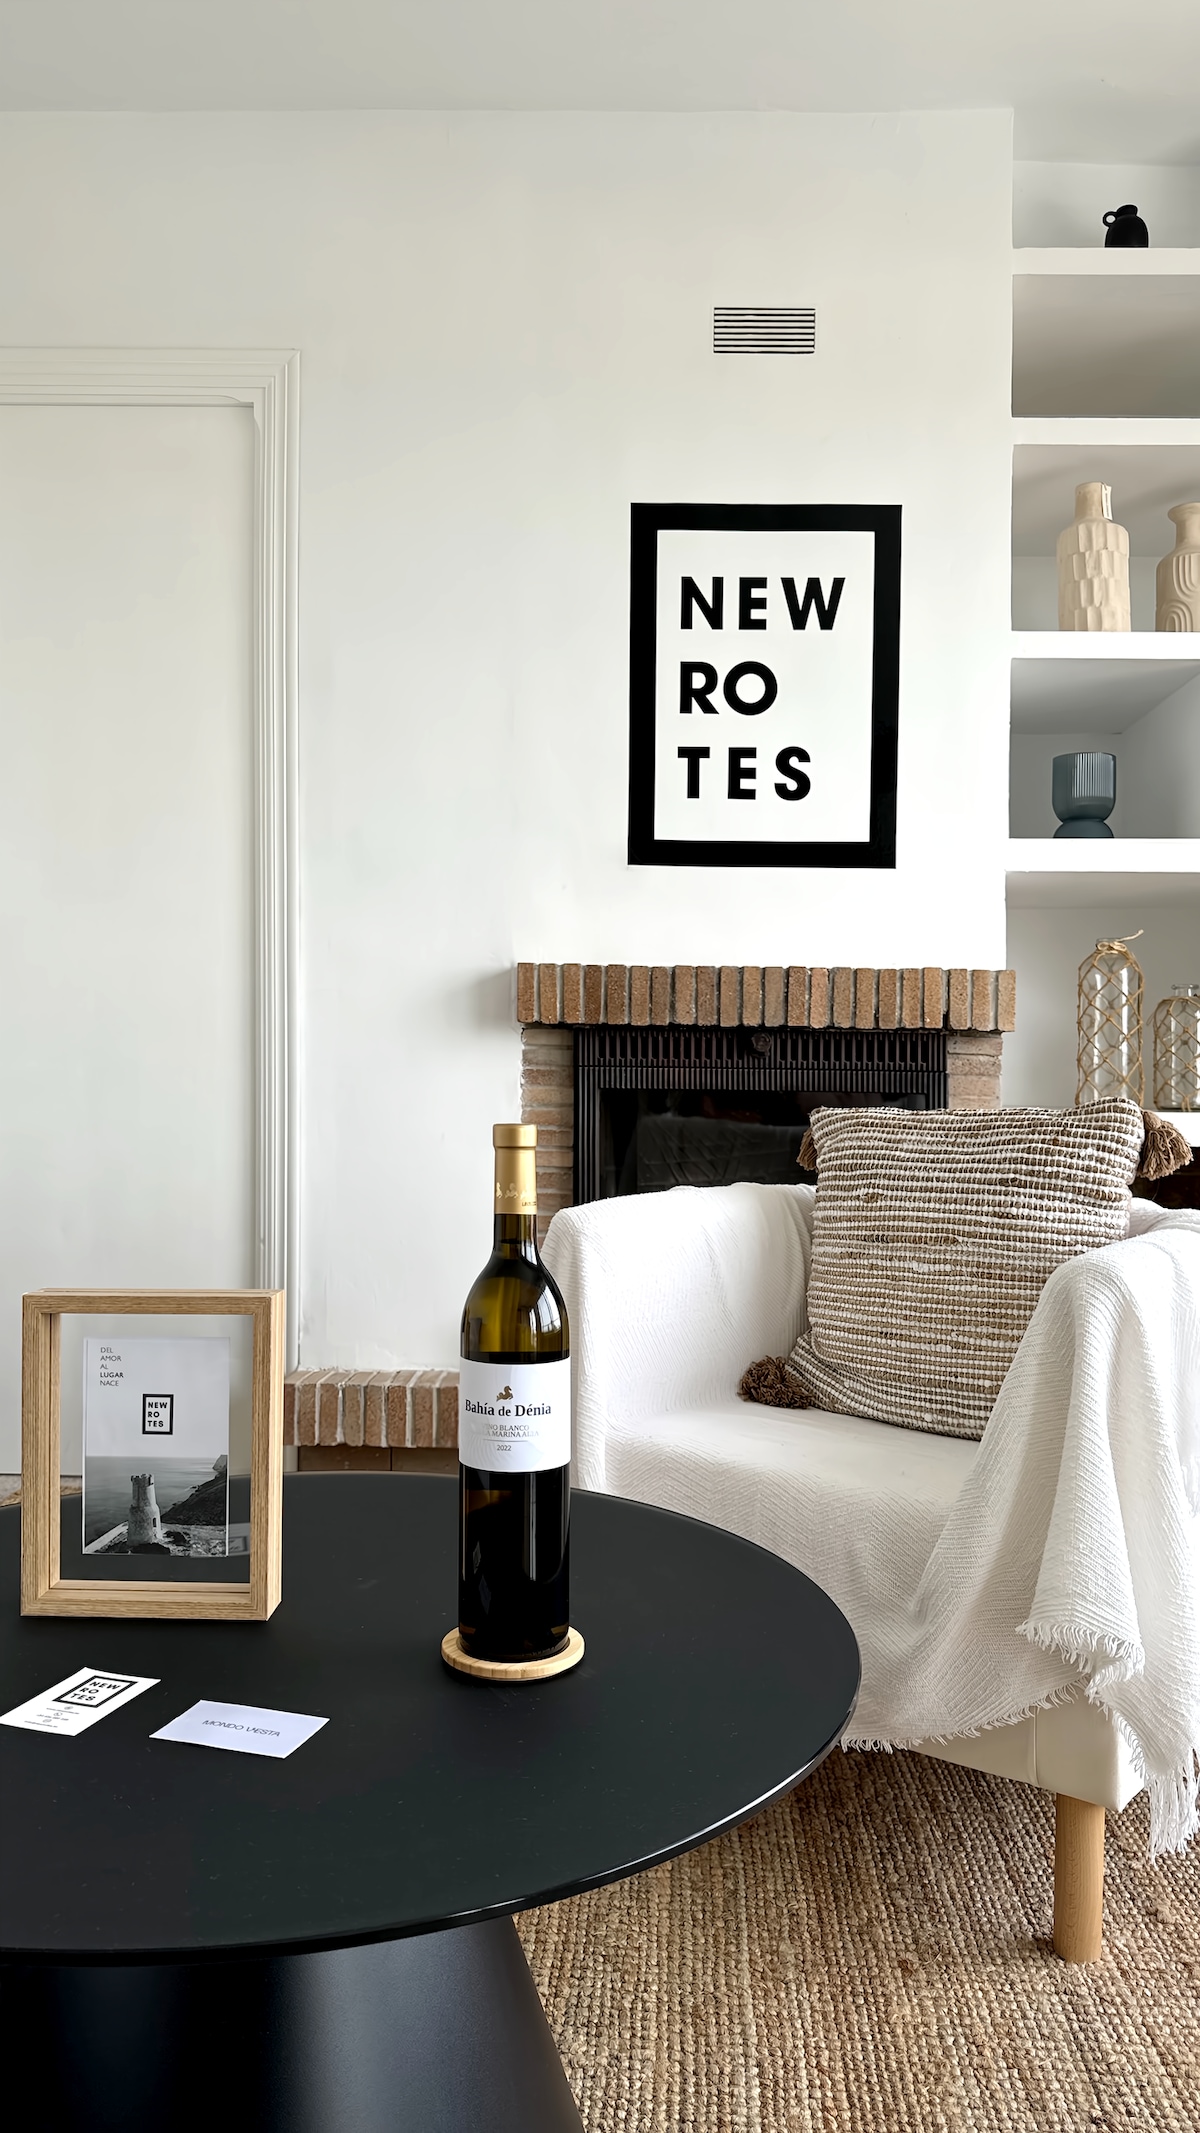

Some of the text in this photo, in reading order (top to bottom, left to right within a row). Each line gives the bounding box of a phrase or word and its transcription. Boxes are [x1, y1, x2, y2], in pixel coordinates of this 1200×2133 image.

[680, 576, 846, 630] NEW
[679, 660, 778, 716] RO
[677, 745, 811, 801] TES
[465, 1399, 551, 1417] Bahía de Dénia
[499, 1424, 530, 1432] BLANCO
[89, 1681, 121, 1690] NEW
[70, 1693, 96, 1701] TES
[202, 1720, 244, 1731] MONDO
